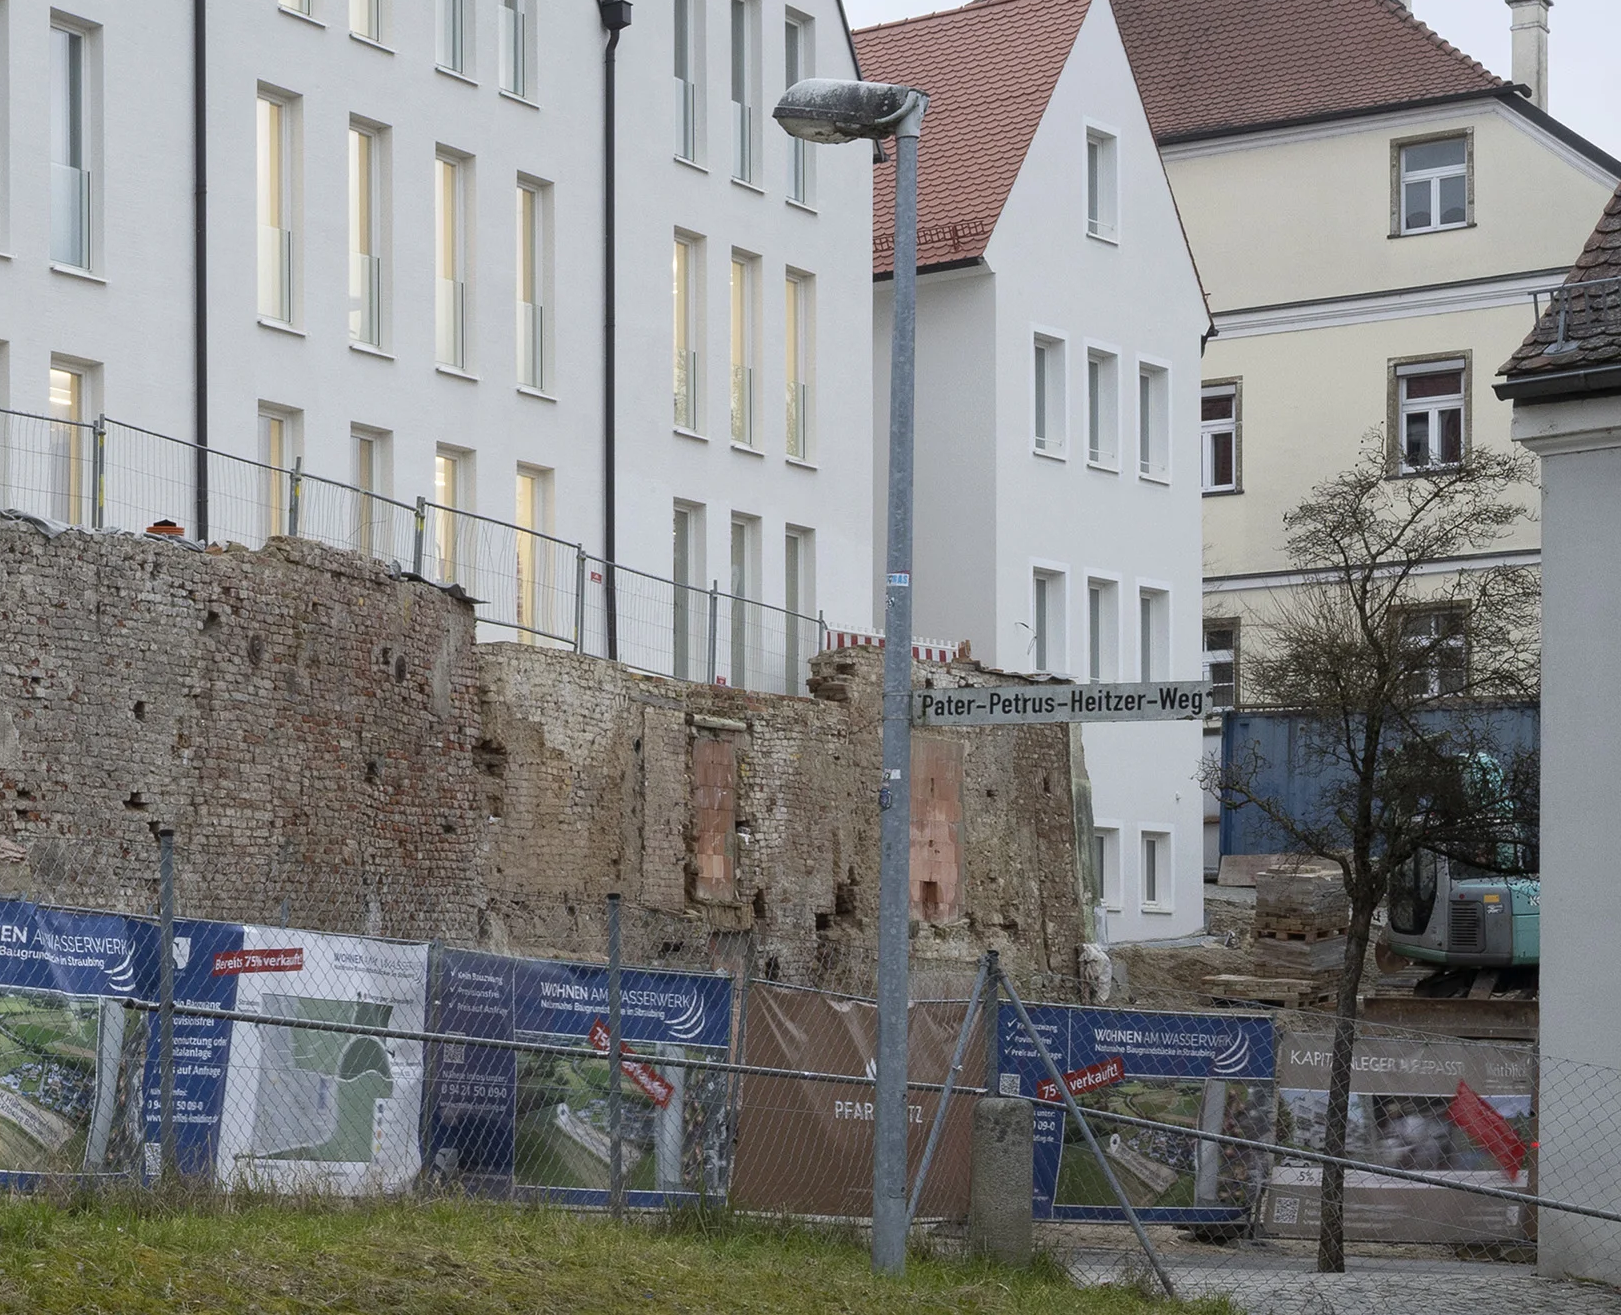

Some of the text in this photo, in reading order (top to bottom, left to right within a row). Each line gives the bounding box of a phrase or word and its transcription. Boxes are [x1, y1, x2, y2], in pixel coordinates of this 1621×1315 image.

[922, 687, 1203, 717] Pater-Petrus-Heitzer-Weg
[67, 956, 105, 970] Straubing
[215, 957, 243, 971] Bereits
[540, 981, 588, 1001] WOHNEN
[620, 990, 691, 1008] ASSERWERK
[1094, 1028, 1142, 1044] WOHNEN
[1143, 1032, 1159, 1044] AM
[1069, 1063, 1118, 1091] verkauft!
[834, 1100, 923, 1124] PFARTZ
